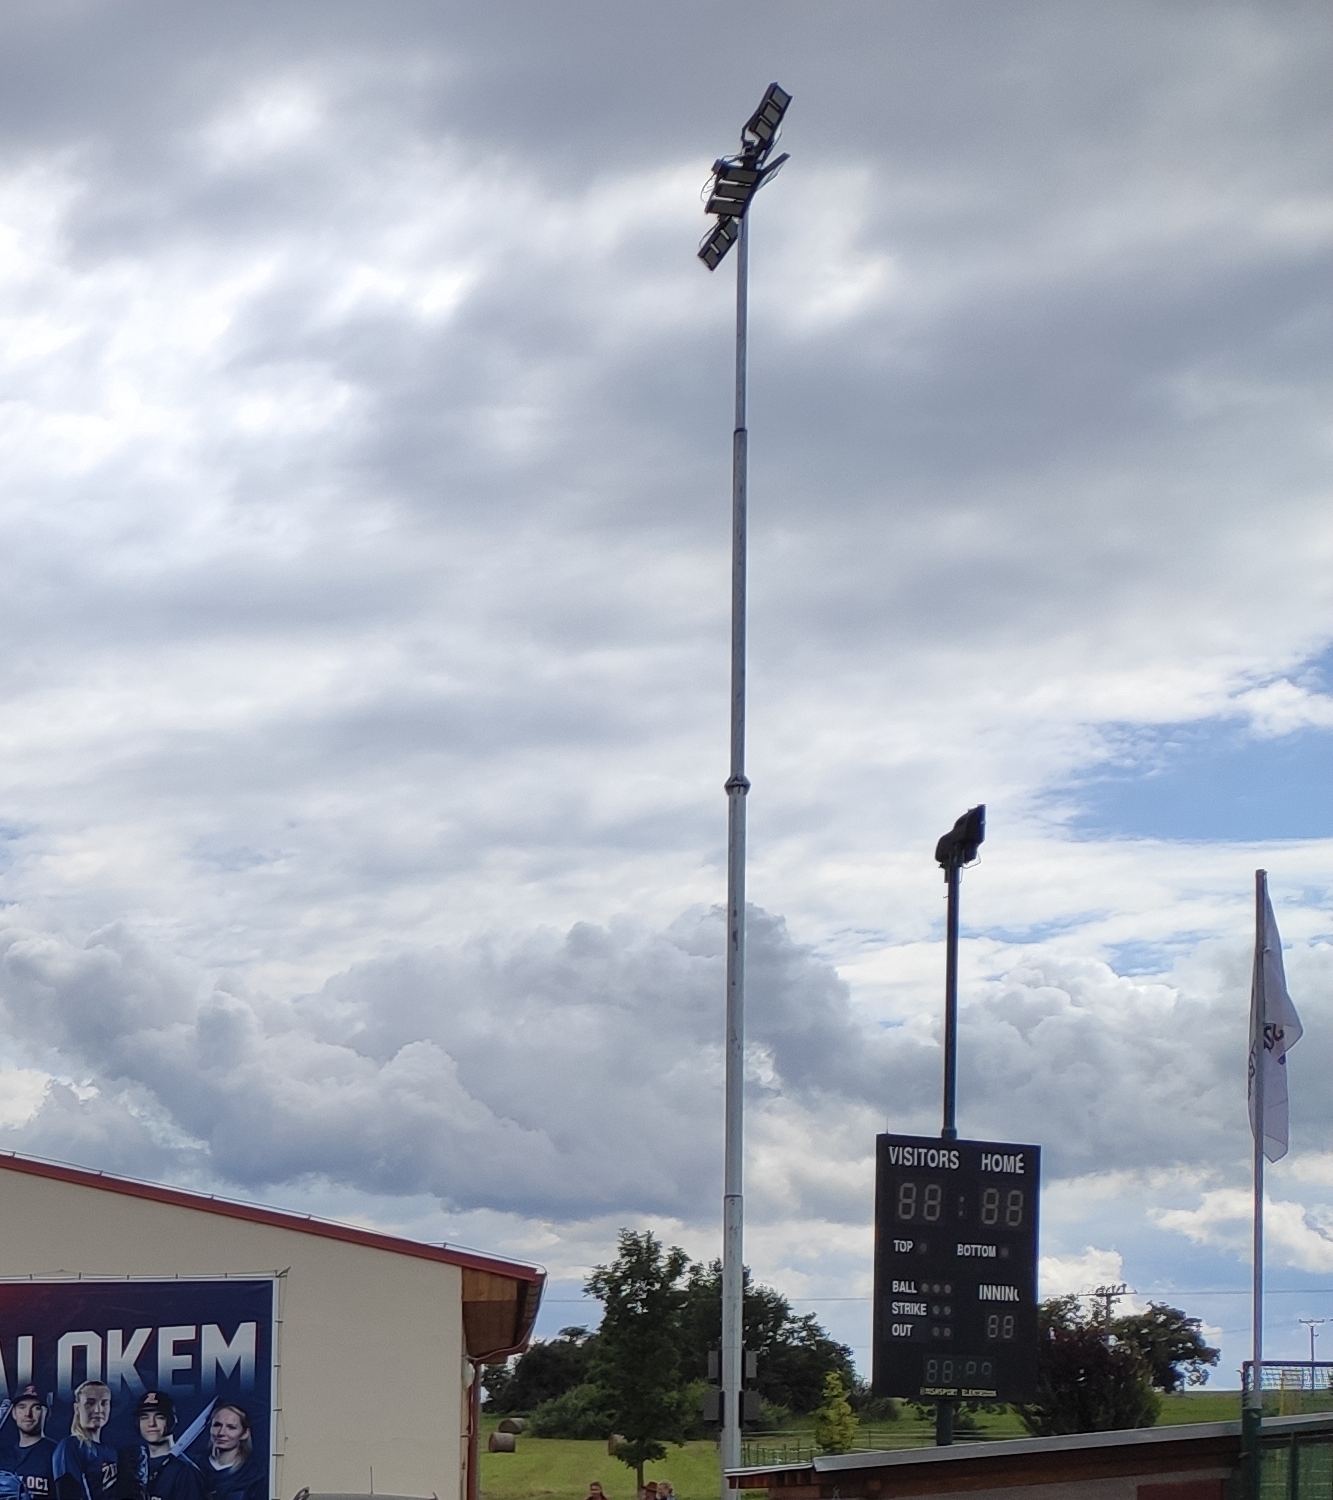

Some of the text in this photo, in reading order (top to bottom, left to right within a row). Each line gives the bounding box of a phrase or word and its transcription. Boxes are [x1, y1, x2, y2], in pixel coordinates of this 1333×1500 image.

[888, 1146, 1025, 1174] VISITORS HOME
[893, 1240, 997, 1257] TOP BOTTOM
[892, 1280, 918, 1293] BALL
[892, 1302, 927, 1316] STRIKE
[892, 1324, 914, 1337] OUT
